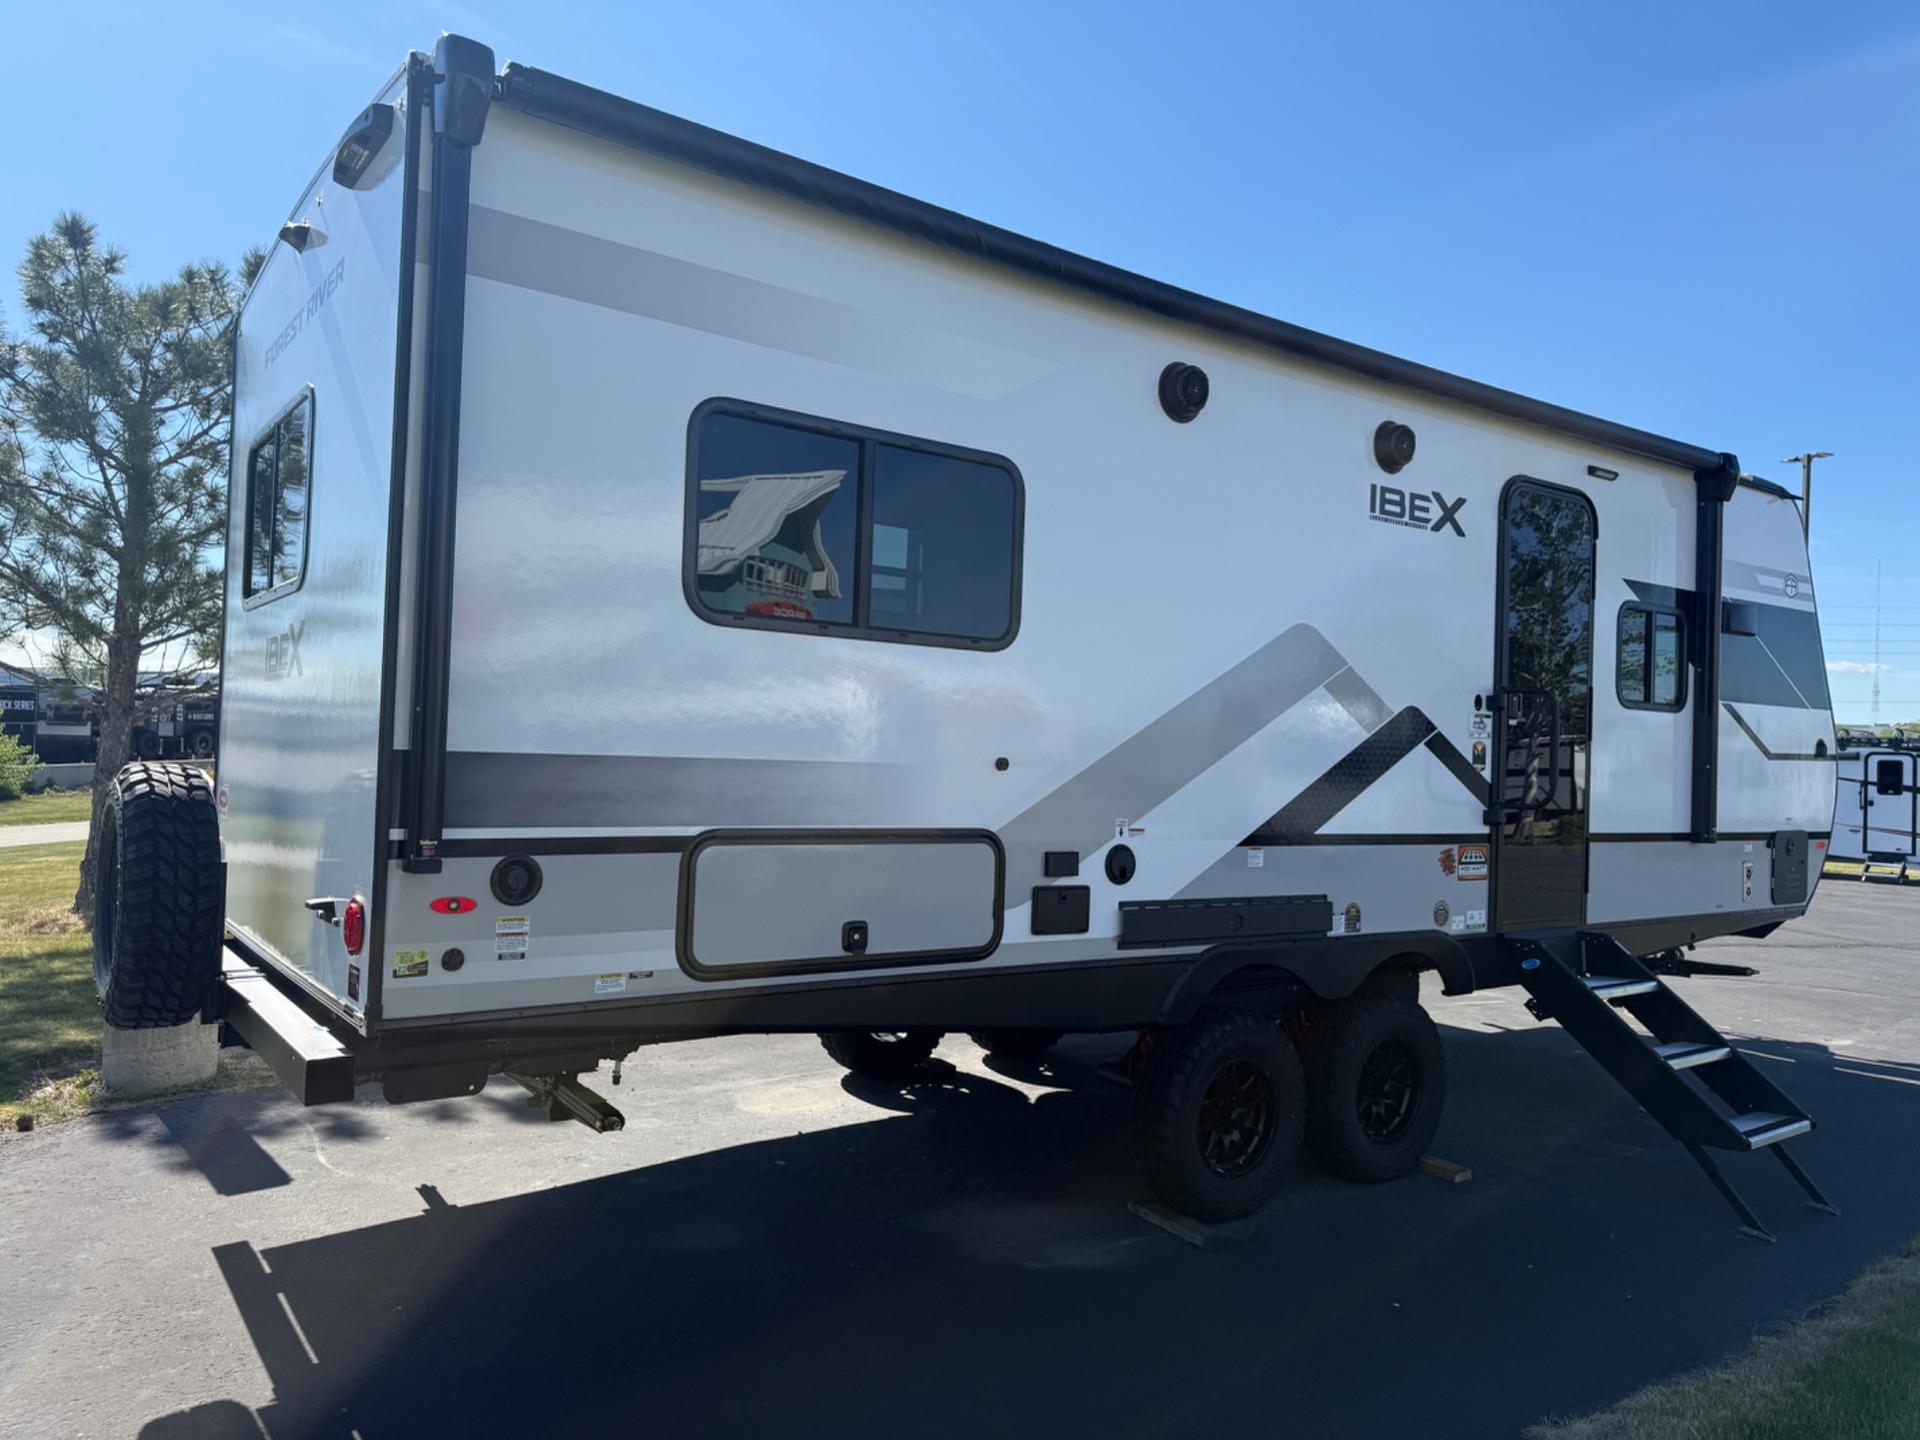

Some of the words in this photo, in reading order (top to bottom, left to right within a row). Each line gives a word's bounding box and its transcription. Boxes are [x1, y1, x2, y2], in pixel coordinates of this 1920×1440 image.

[264, 307, 305, 370] FOREST
[306, 257, 345, 322] RIVER
[1370, 483, 1467, 538] IBEX
[265, 620, 305, 677] IBEX
[13, 700, 34, 710] SERIES
